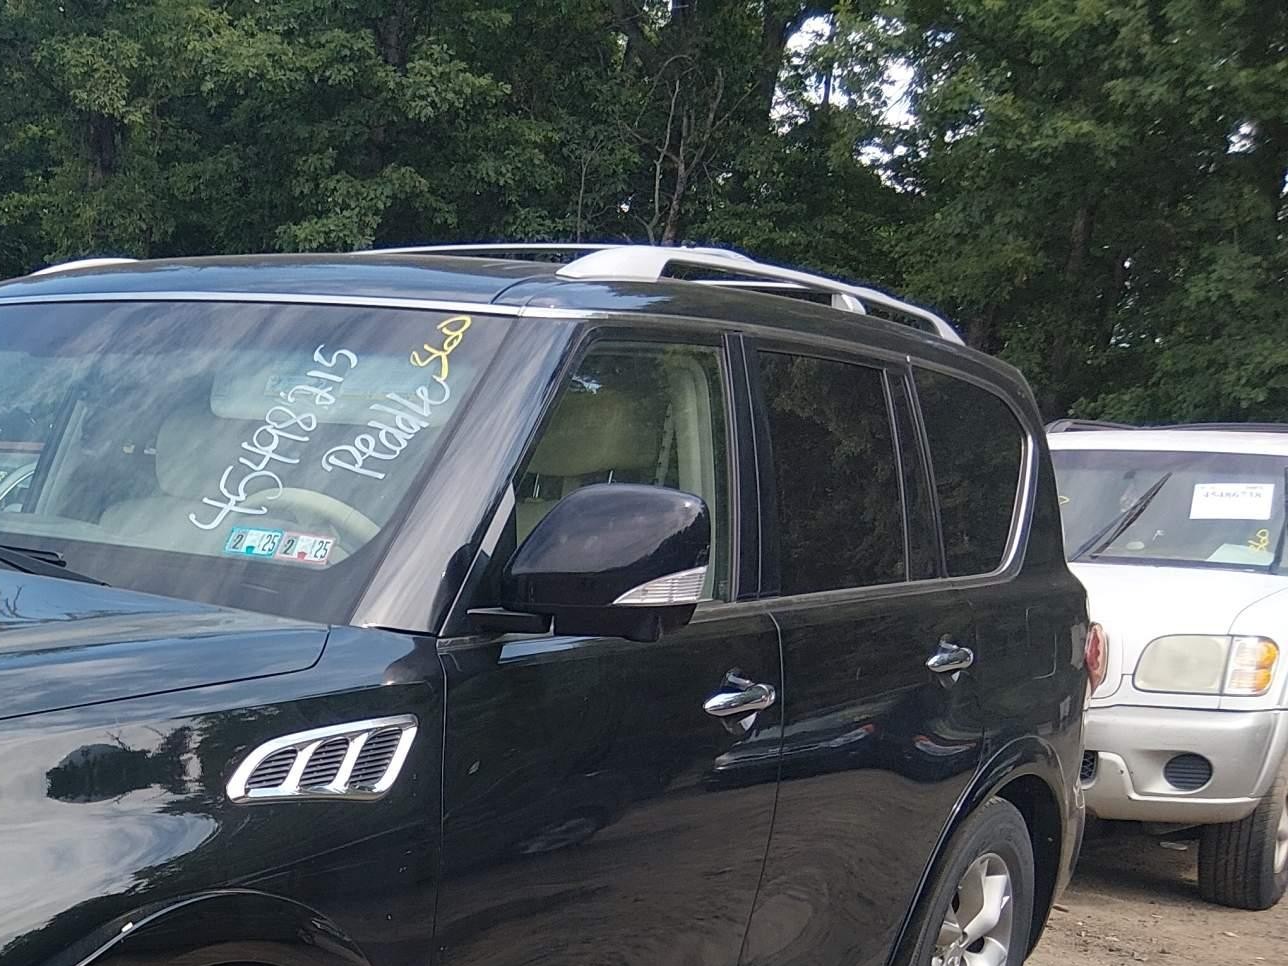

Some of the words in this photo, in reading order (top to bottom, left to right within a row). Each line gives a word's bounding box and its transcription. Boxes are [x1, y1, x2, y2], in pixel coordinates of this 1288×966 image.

[188, 343, 359, 531] 45498215
[232, 534, 244, 550] 2
[261, 534, 279, 552] 25
[283, 539, 295, 555] 2
[313, 540, 331, 560] 25
